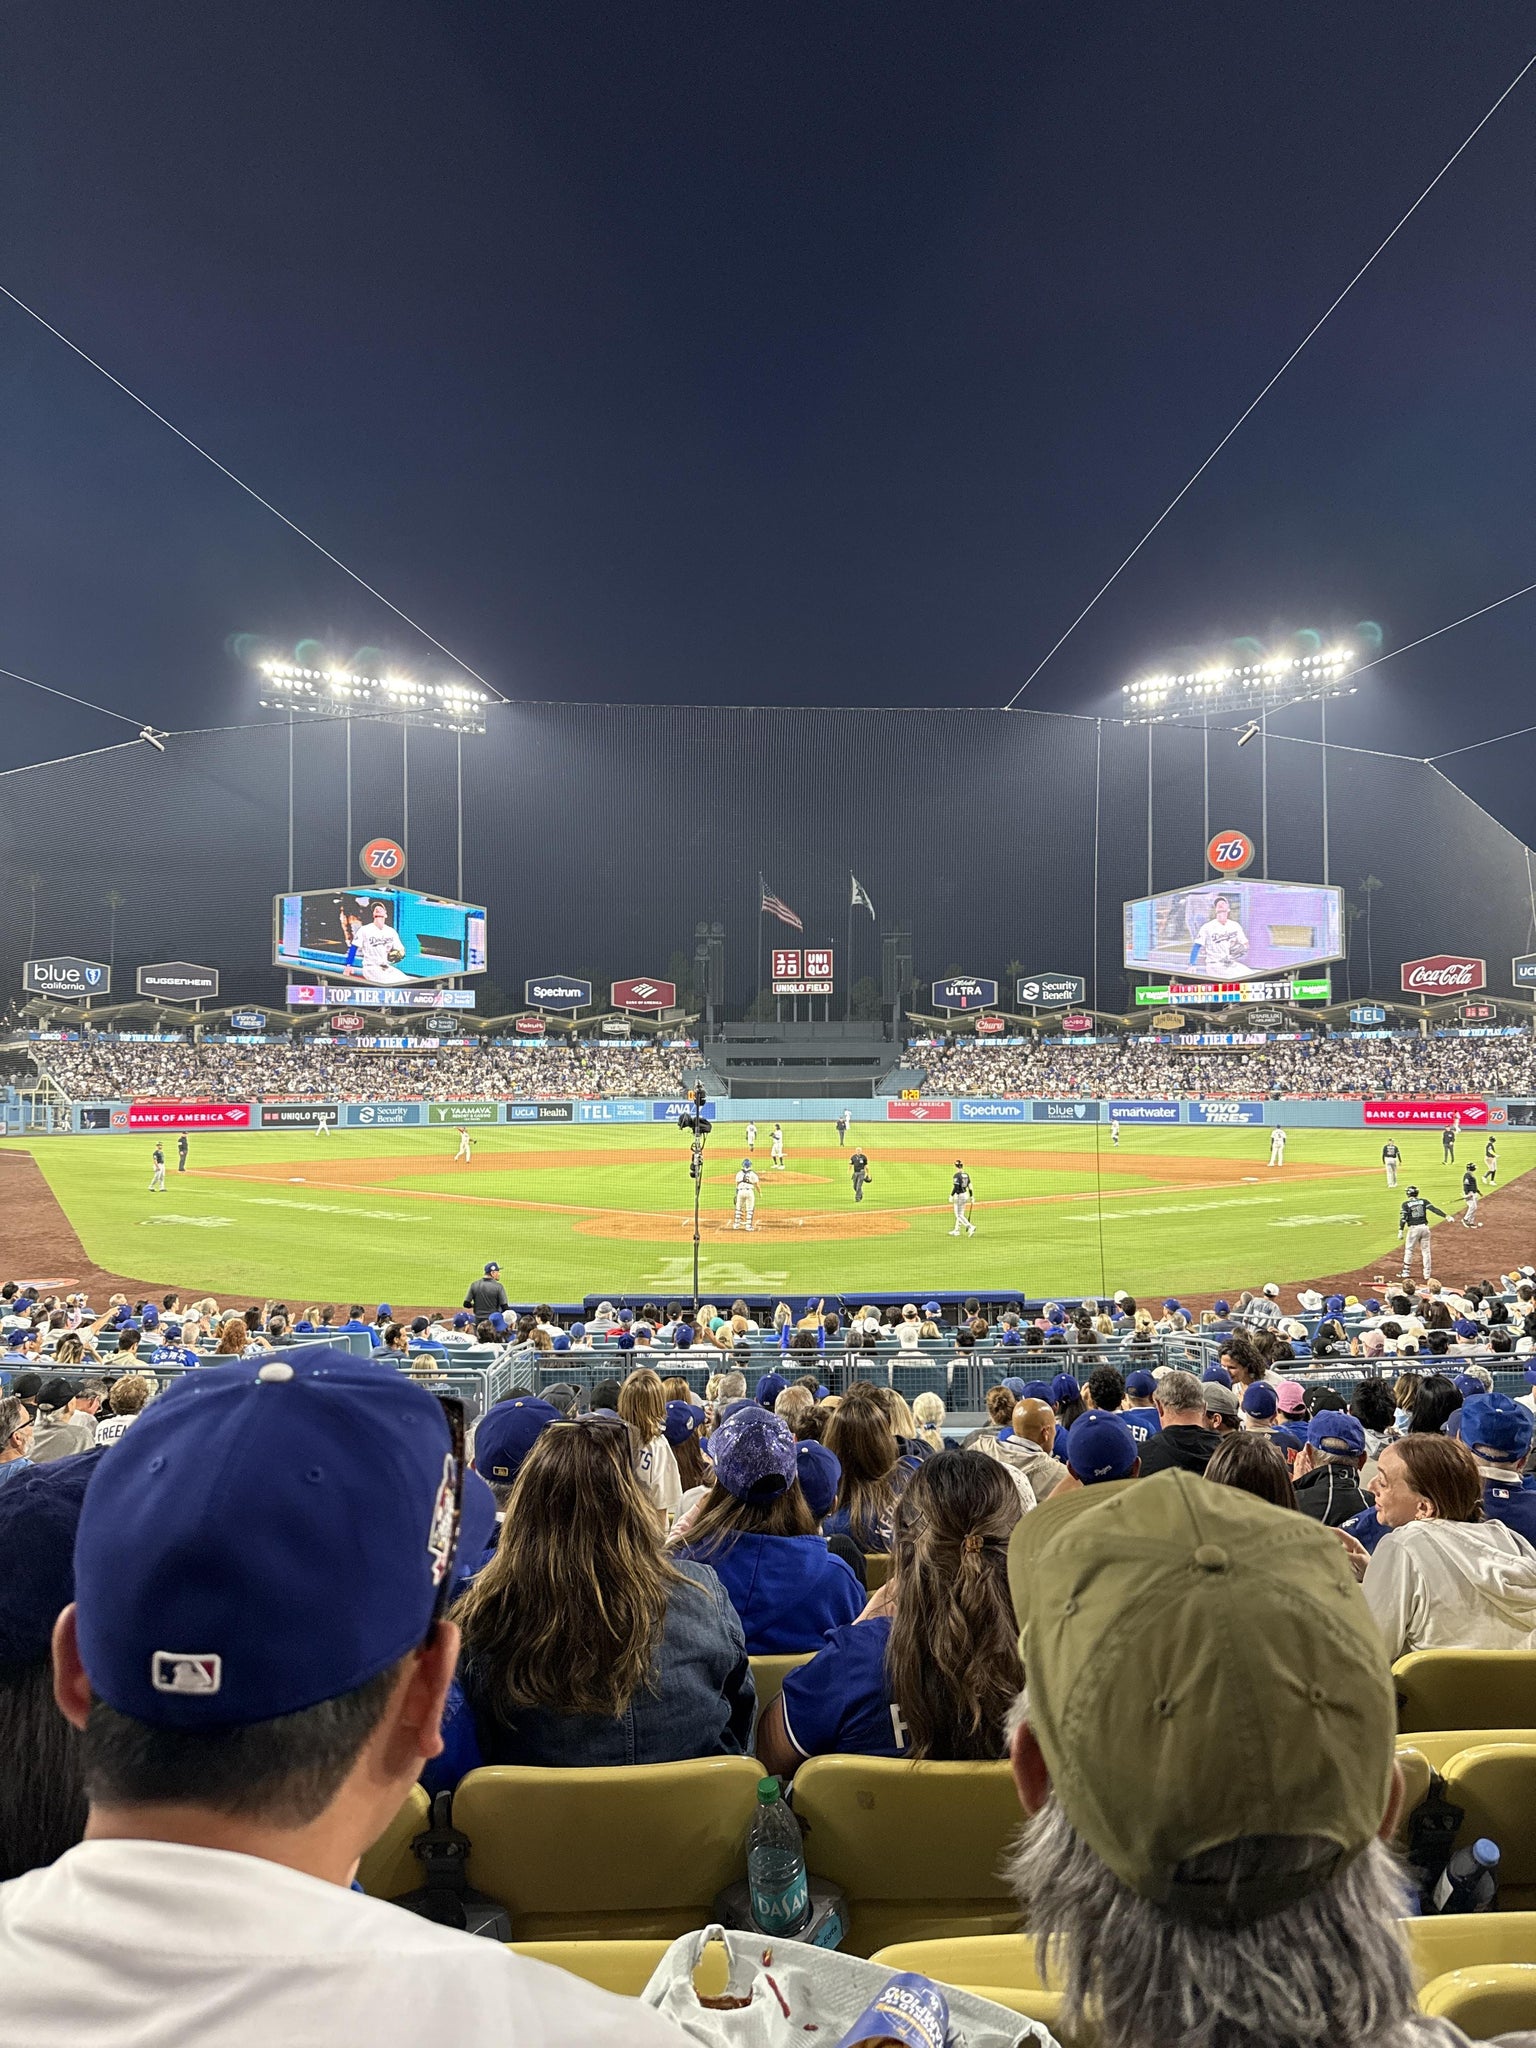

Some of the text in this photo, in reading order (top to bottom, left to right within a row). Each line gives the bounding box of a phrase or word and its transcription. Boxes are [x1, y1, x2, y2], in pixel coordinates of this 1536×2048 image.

[1216, 839, 1244, 863] 76
[371, 848, 398, 869] 76
[808, 954, 828, 964] UNI
[34, 964, 80, 982] blue
[808, 964, 830, 976] QLO
[1519, 967, 1536, 977] UC
[1408, 964, 1476, 987] Coca-Cola
[41, 982, 85, 991] california
[145, 977, 212, 986] GUGGENHEIM
[1042, 981, 1078, 992] Security
[533, 986, 581, 999] Spectrum
[776, 984, 830, 993] UNIQLO FIELD
[945, 986, 982, 996] ULTRA
[329, 989, 412, 1004] TOP TIER PLAY
[413, 996, 434, 1004] ARCO
[1042, 991, 1073, 1000] Benefit
[1354, 1010, 1381, 1021] TEL
[337, 1018, 360, 1027] JINRO
[356, 1037, 376, 1048] TOP
[379, 1037, 403, 1048] TIER
[1180, 1035, 1200, 1045] TOP
[1202, 1035, 1227, 1045] TIER
[377, 1106, 408, 1115] Security
[514, 1108, 568, 1117] UCLA Health
[581, 1105, 612, 1119] TEL
[666, 1104, 690, 1114] ANA
[963, 1104, 1015, 1117] Spectrum
[1048, 1104, 1073, 1115] blue
[1112, 1107, 1176, 1117] smartwater
[1199, 1104, 1240, 1113] TOYO
[113, 1114, 127, 1124] 76
[131, 1113, 224, 1122] BANK OF AMERICA
[281, 1111, 311, 1120] UNIQLO
[377, 1114, 404, 1123] Benefit
[1205, 1113, 1250, 1123] TIRES
[1366, 1111, 1395, 1119] BANK
[1396, 1111, 1412, 1119] OF
[1491, 1110, 1504, 1120] 76
